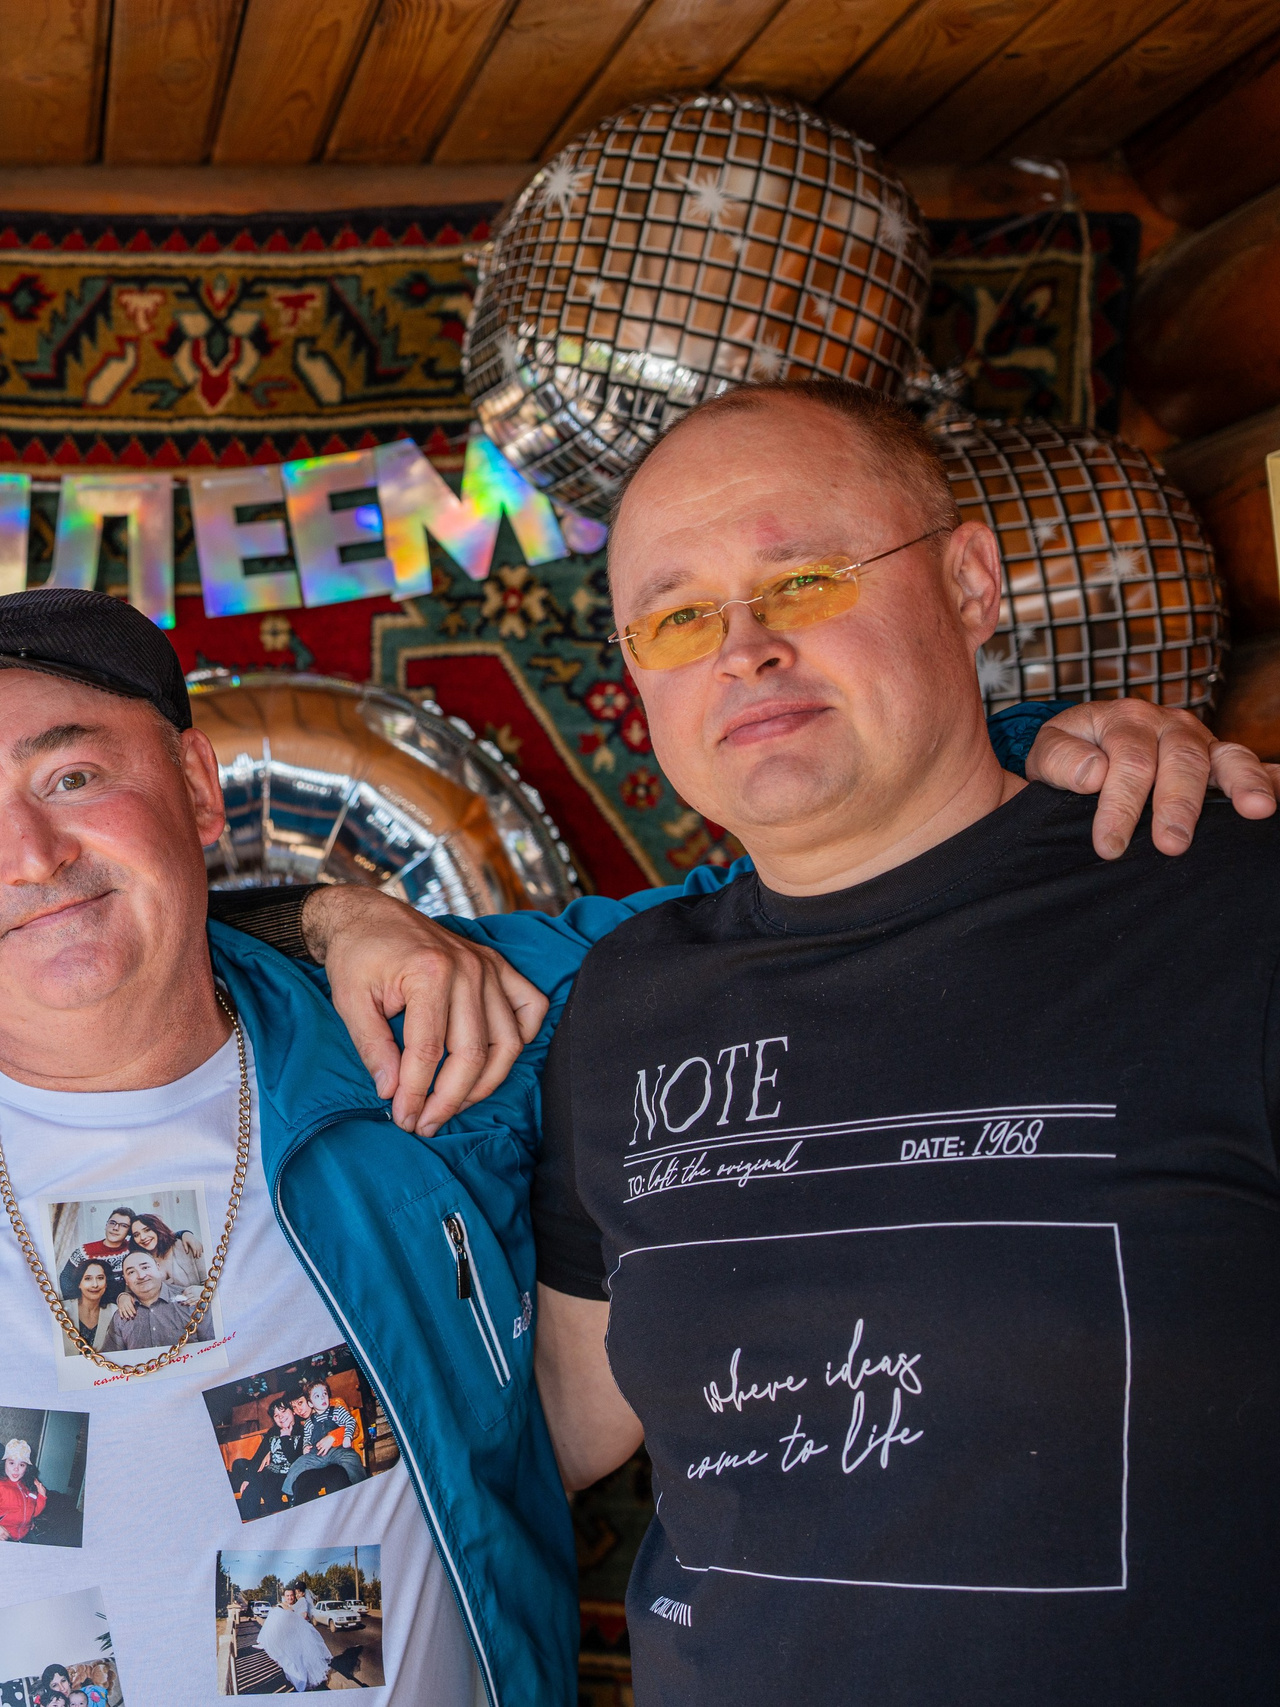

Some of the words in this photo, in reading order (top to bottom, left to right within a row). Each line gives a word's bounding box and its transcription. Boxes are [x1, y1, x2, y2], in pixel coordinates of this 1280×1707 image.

[629, 1036, 788, 1145] NOTE
[628, 1174, 646, 1197] TO:
[647, 1156, 680, 1192] loft
[680, 1151, 711, 1184] the
[716, 1140, 804, 1188] original
[900, 1136, 966, 1161] DATE:
[971, 1119, 1044, 1156] 1968
[703, 1348, 808, 1413] where
[825, 1318, 922, 1394] ideas
[687, 1446, 768, 1480] come
[779, 1415, 828, 1472] to
[842, 1388, 925, 1474] life
